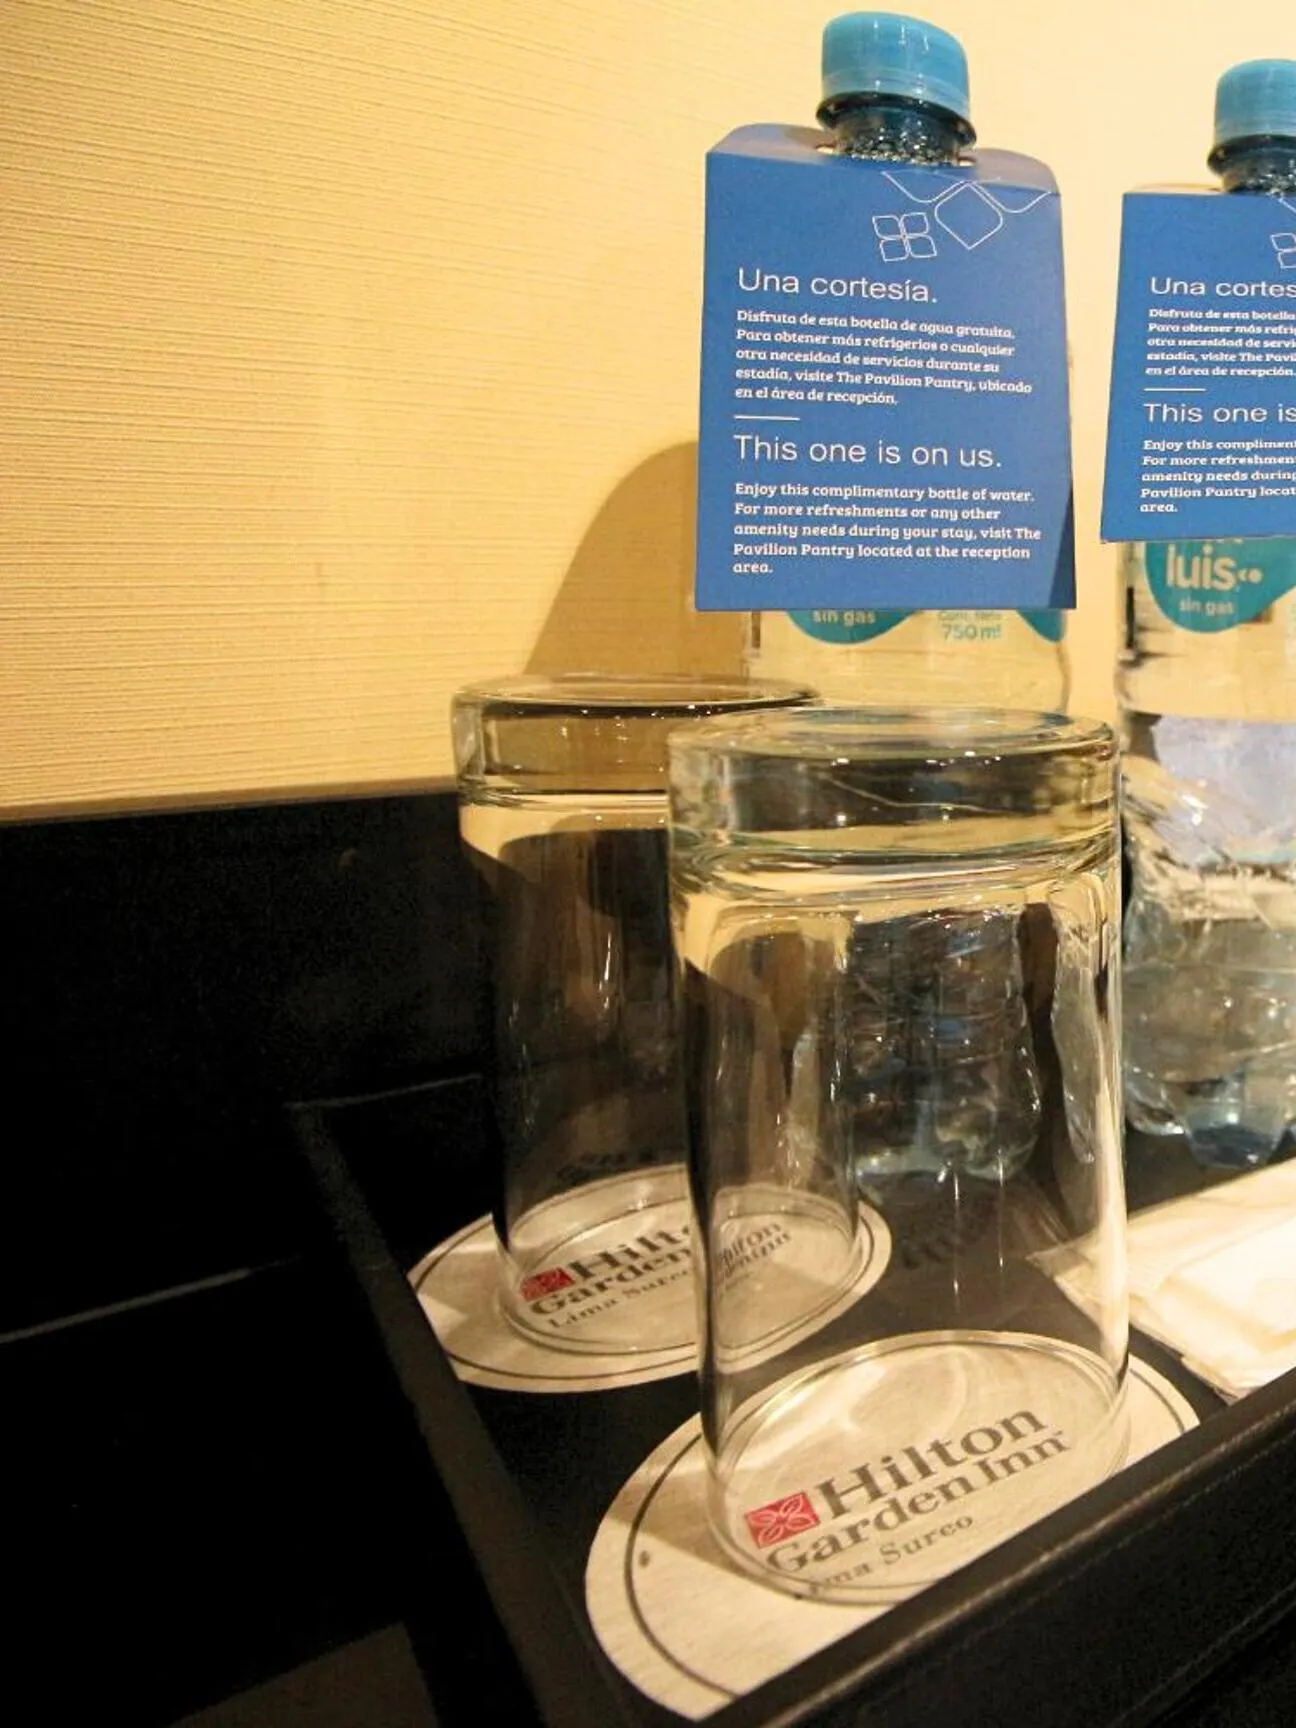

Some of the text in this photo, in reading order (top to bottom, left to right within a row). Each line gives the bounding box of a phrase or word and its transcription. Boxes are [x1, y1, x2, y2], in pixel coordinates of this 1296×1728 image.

[738, 267, 938, 303] Una cortesía.
[1149, 276, 1207, 296] Una
[736, 309, 797, 325] Disfruta
[798, 312, 816, 325] de
[818, 316, 848, 327] esta
[850, 316, 898, 330] botella
[899, 319, 918, 332] de
[918, 322, 954, 336] agua
[1148, 308, 1203, 319] Disfruta
[1204, 309, 1221, 319] de
[1222, 311, 1250, 319] esta
[1251, 310, 1296, 320] botella
[1148, 322, 1180, 332] Para
[1181, 323, 1233, 333] obtener
[1234, 324, 1262, 334] más
[736, 328, 1015, 357] Para obtener más refrigerios o cualquier
[1146, 337, 1176, 346] otra
[1178, 338, 1243, 347] necesidad
[1245, 338, 1260, 348] de
[735, 349, 1000, 373] otra necesidad de servicios durante su
[1200, 352, 1237, 362] visite
[1239, 352, 1263, 362] The
[1145, 367, 1162, 376] en
[1164, 366, 1176, 376] el
[1178, 365, 1209, 376] área
[1211, 366, 1228, 376] de
[794, 369, 834, 382] visite
[835, 371, 863, 384] The
[864, 373, 923, 387] Pavilion
[977, 379, 1033, 394] ubicado
[735, 388, 753, 399] en
[755, 386, 768, 399] el
[770, 386, 805, 400] área
[806, 388, 824, 402] de
[1142, 402, 1204, 423] This
[1212, 407, 1269, 422] one
[732, 434, 1002, 468] This one is on us.
[1143, 439, 1183, 452] Enjoy
[1186, 439, 1214, 450] this
[1142, 455, 1167, 466] For
[1170, 457, 1208, 465] more
[1141, 471, 1204, 484] amenity
[1205, 471, 1248, 481] needs
[735, 482, 778, 498] Enjoy
[779, 483, 810, 496] this
[811, 485, 926, 502] complimentary
[927, 487, 970, 501] bottle
[971, 488, 987, 501] of
[1140, 487, 1202, 499] Pavilion
[1204, 486, 1257, 498] Pantry
[734, 502, 1001, 521] For more refreshments or any other
[1139, 503, 1179, 513] area.
[733, 523, 1042, 541] amenity needs during your stay, visit The
[733, 542, 1031, 561] Pavilion Pantry located at the reception
[731, 562, 774, 574] area.
[941, 623, 977, 641] 750
[815, 1409, 1050, 1520] Hilton
[766, 1473, 979, 1574] Garden
[879, 1515, 974, 1565] Surco
